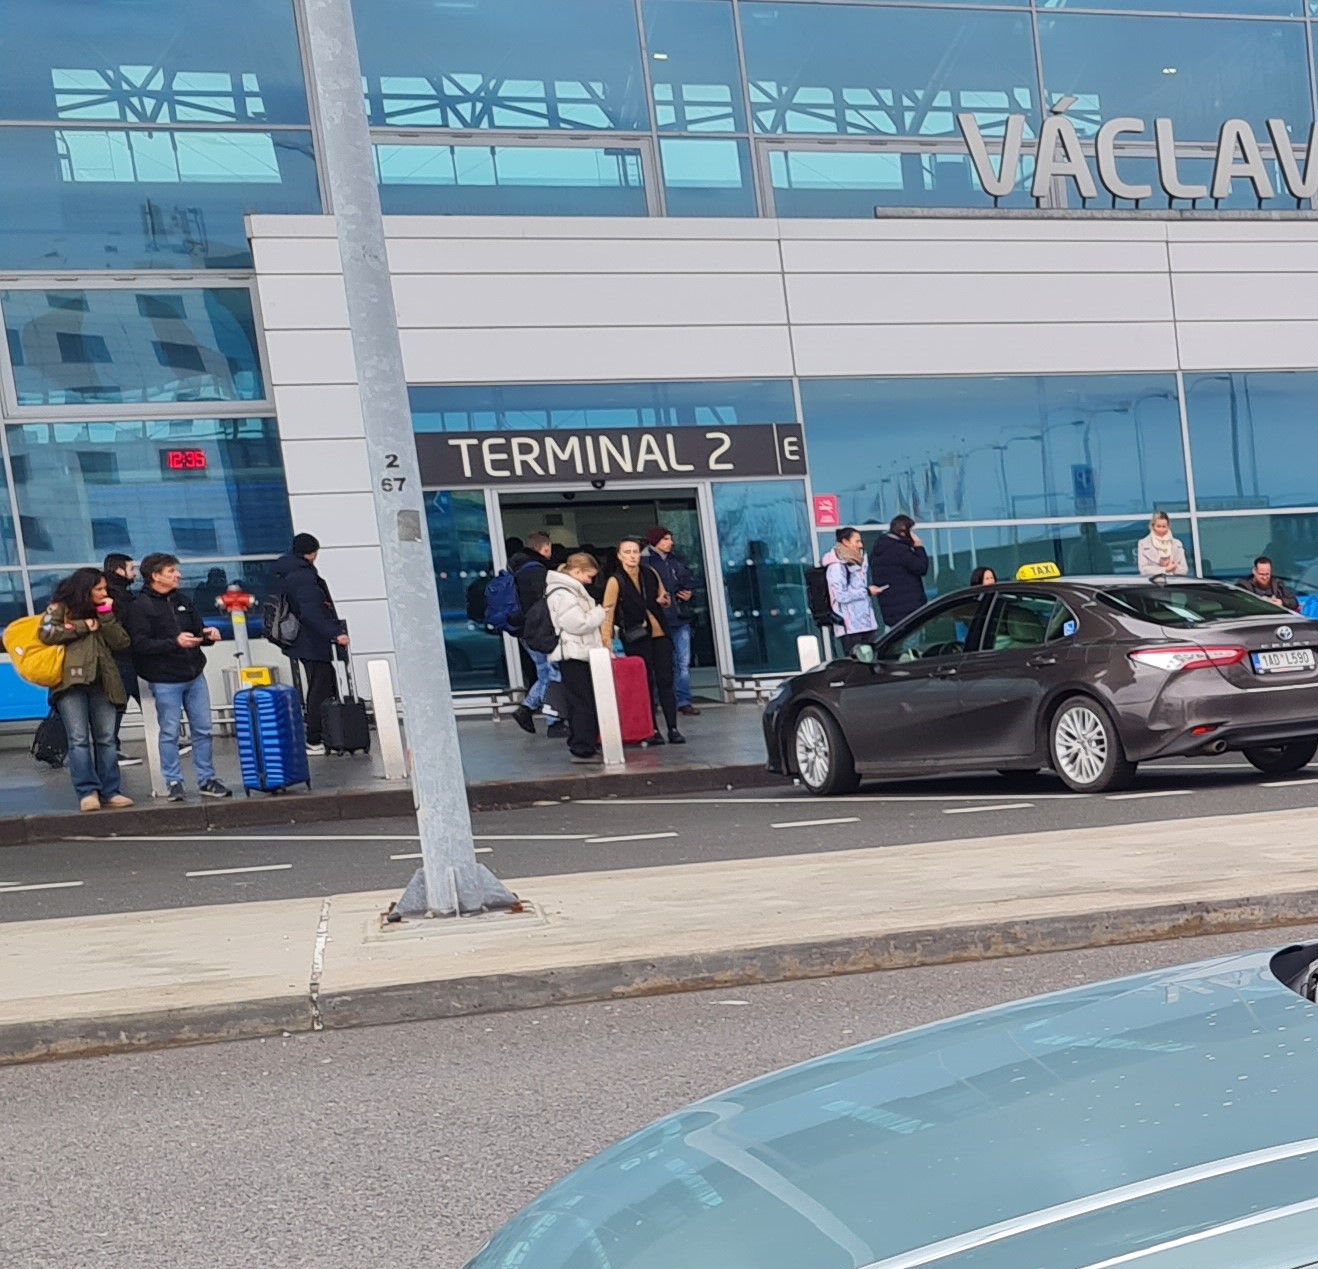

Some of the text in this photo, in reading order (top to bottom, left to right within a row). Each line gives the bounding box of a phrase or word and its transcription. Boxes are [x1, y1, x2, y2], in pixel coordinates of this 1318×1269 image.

[447, 431, 735, 478] TERMINAL 2
[783, 435, 801, 462] E
[168, 450, 207, 469] 12:35
[384, 453, 400, 469] 2
[381, 477, 406, 492] 67
[1030, 565, 1056, 576] TAXI
[1262, 651, 1309, 667] 1AD L590
